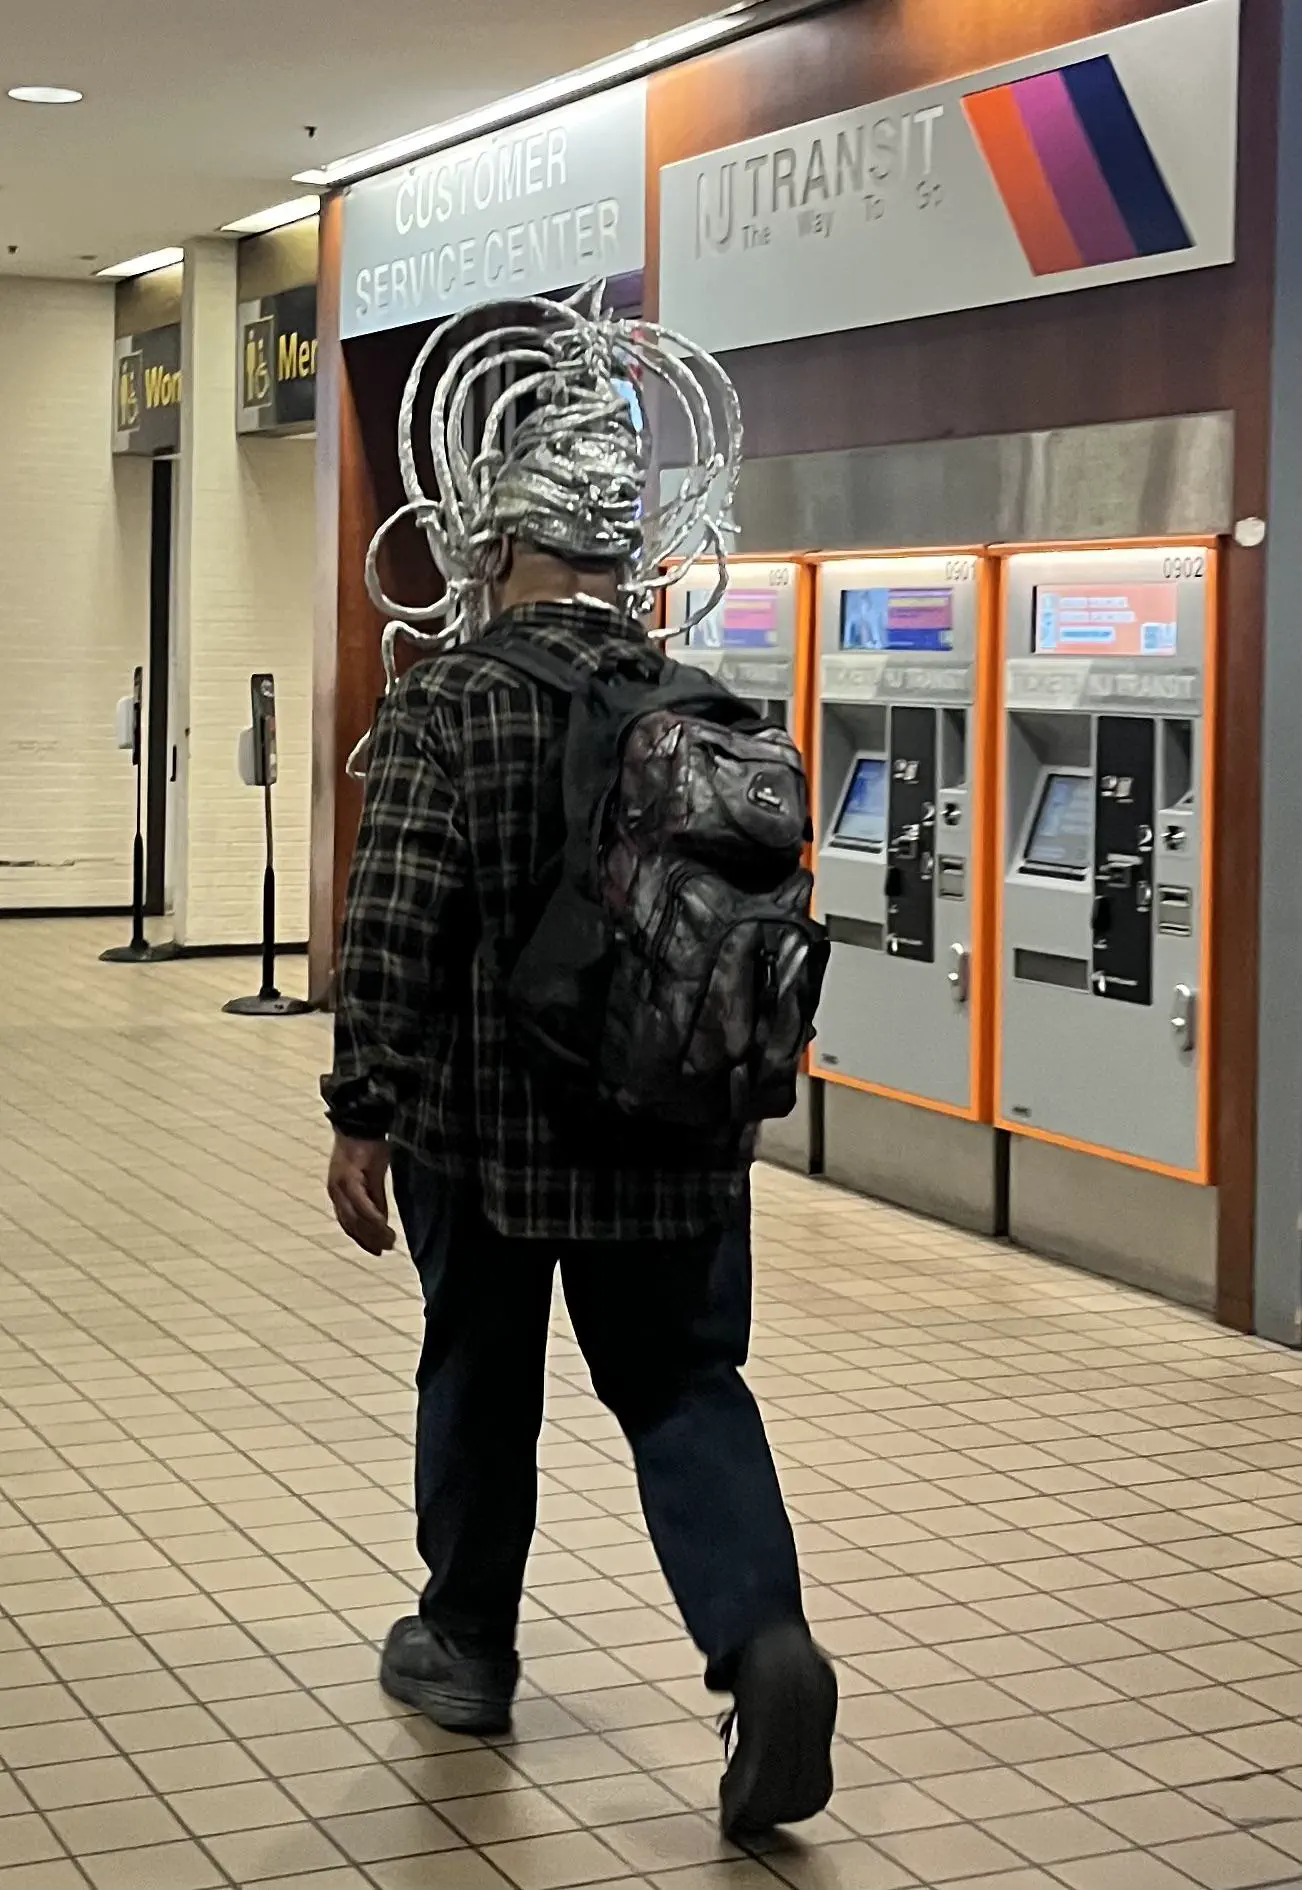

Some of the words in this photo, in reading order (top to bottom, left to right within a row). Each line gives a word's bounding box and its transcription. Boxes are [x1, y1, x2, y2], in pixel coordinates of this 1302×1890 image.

[395, 126, 568, 235] CUSTOMER
[743, 104, 944, 218] TRANSIT
[355, 238, 477, 317] SERVICE
[484, 197, 621, 289] CENTER
[741, 223, 771, 250] The
[797, 209, 836, 238] Way
[862, 193, 885, 222] To
[1163, 556, 1204, 579] 0902
